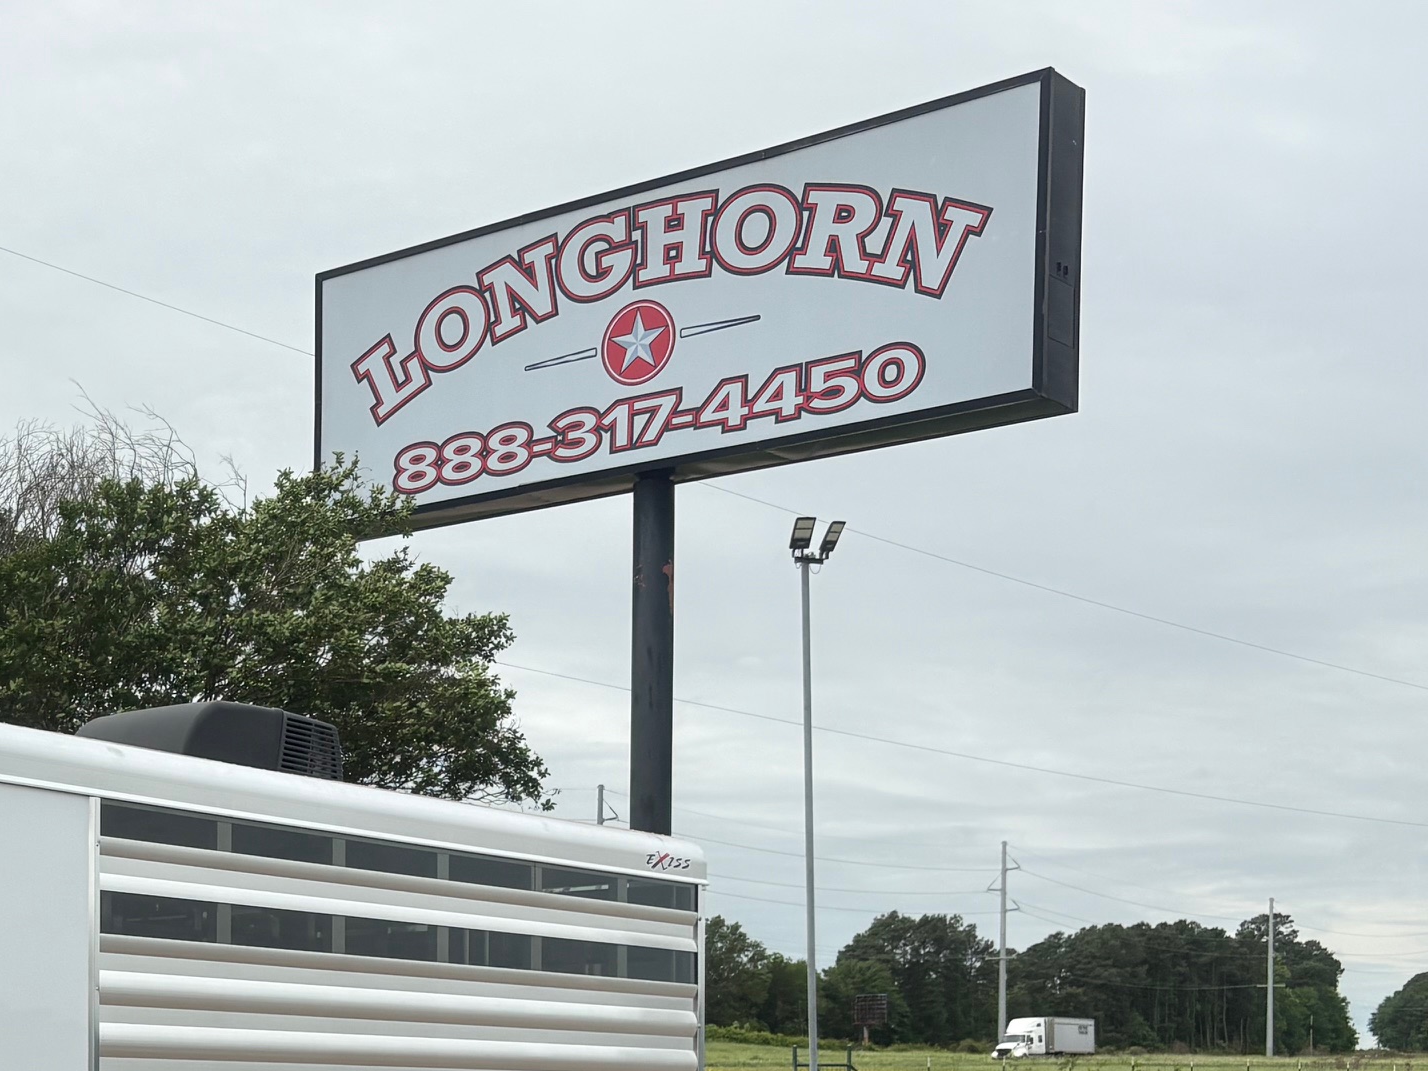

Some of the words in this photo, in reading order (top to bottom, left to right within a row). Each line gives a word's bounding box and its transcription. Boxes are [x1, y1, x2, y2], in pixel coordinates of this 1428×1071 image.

[352, 183, 993, 427] LONGHORN
[392, 341, 927, 495] 888-317-4450
[646, 850, 691, 871] EXISS
